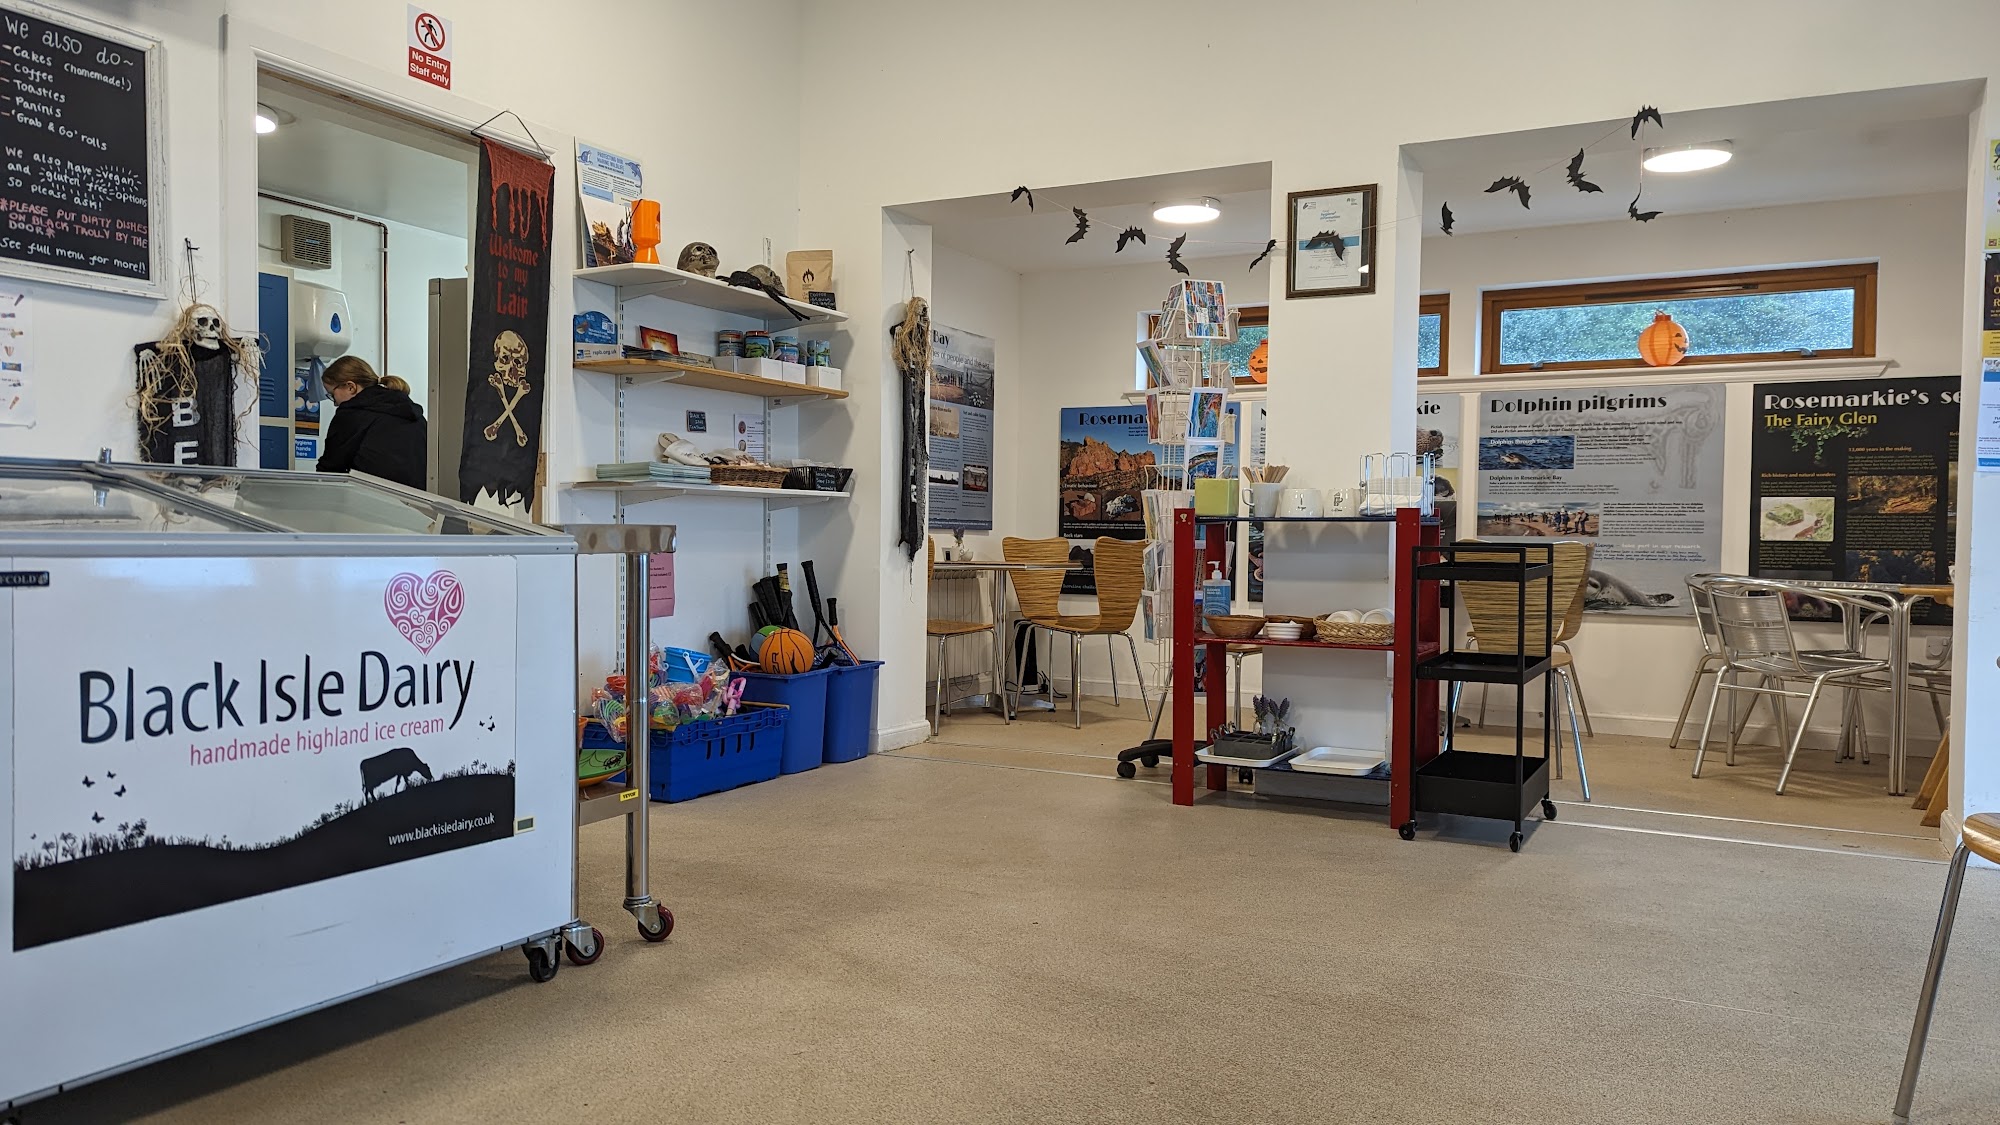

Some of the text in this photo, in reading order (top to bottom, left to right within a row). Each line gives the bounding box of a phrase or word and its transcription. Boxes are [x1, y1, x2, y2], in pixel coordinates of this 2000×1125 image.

[42, 30, 82, 54] also
[412, 51, 448, 73] No Entry
[410, 63, 449, 86] Staff only
[13, 79, 66, 103] Toasties
[15, 96, 62, 118] Paninis
[48, 122, 55, 133] &
[81, 135, 107, 151] rolls
[33, 153, 61, 166] also
[67, 161, 92, 175] have
[102, 172, 134, 186] vegan
[7, 163, 147, 208] and gluten free options
[31, 184, 67, 200] please
[74, 197, 102, 211] ask!
[9, 212, 148, 248] ON BLACK TROLLY BY THE
[57, 209, 77, 222] PUT
[82, 214, 112, 228] DIRTY
[117, 219, 148, 234] DISHES
[28, 243, 51, 255] full
[56, 247, 85, 260] menu
[89, 255, 109, 266] for
[489, 234, 538, 266] Welcome
[498, 261, 528, 287] to my
[497, 281, 528, 318] Lair
[933, 330, 950, 348] Bay
[947, 353, 963, 364] people
[1491, 393, 1667, 414] Dolphin pilgrims
[1764, 389, 1960, 410] Rosemarkie's se
[1765, 411, 1878, 428] The Fairy Glen
[0, 574, 37, 585] COLD
[79, 650, 475, 744] Black Isle Dairy
[189, 716, 445, 767] handmade highland ice cream
[388, 812, 496, 846] www.blackisledairy.co.uk
